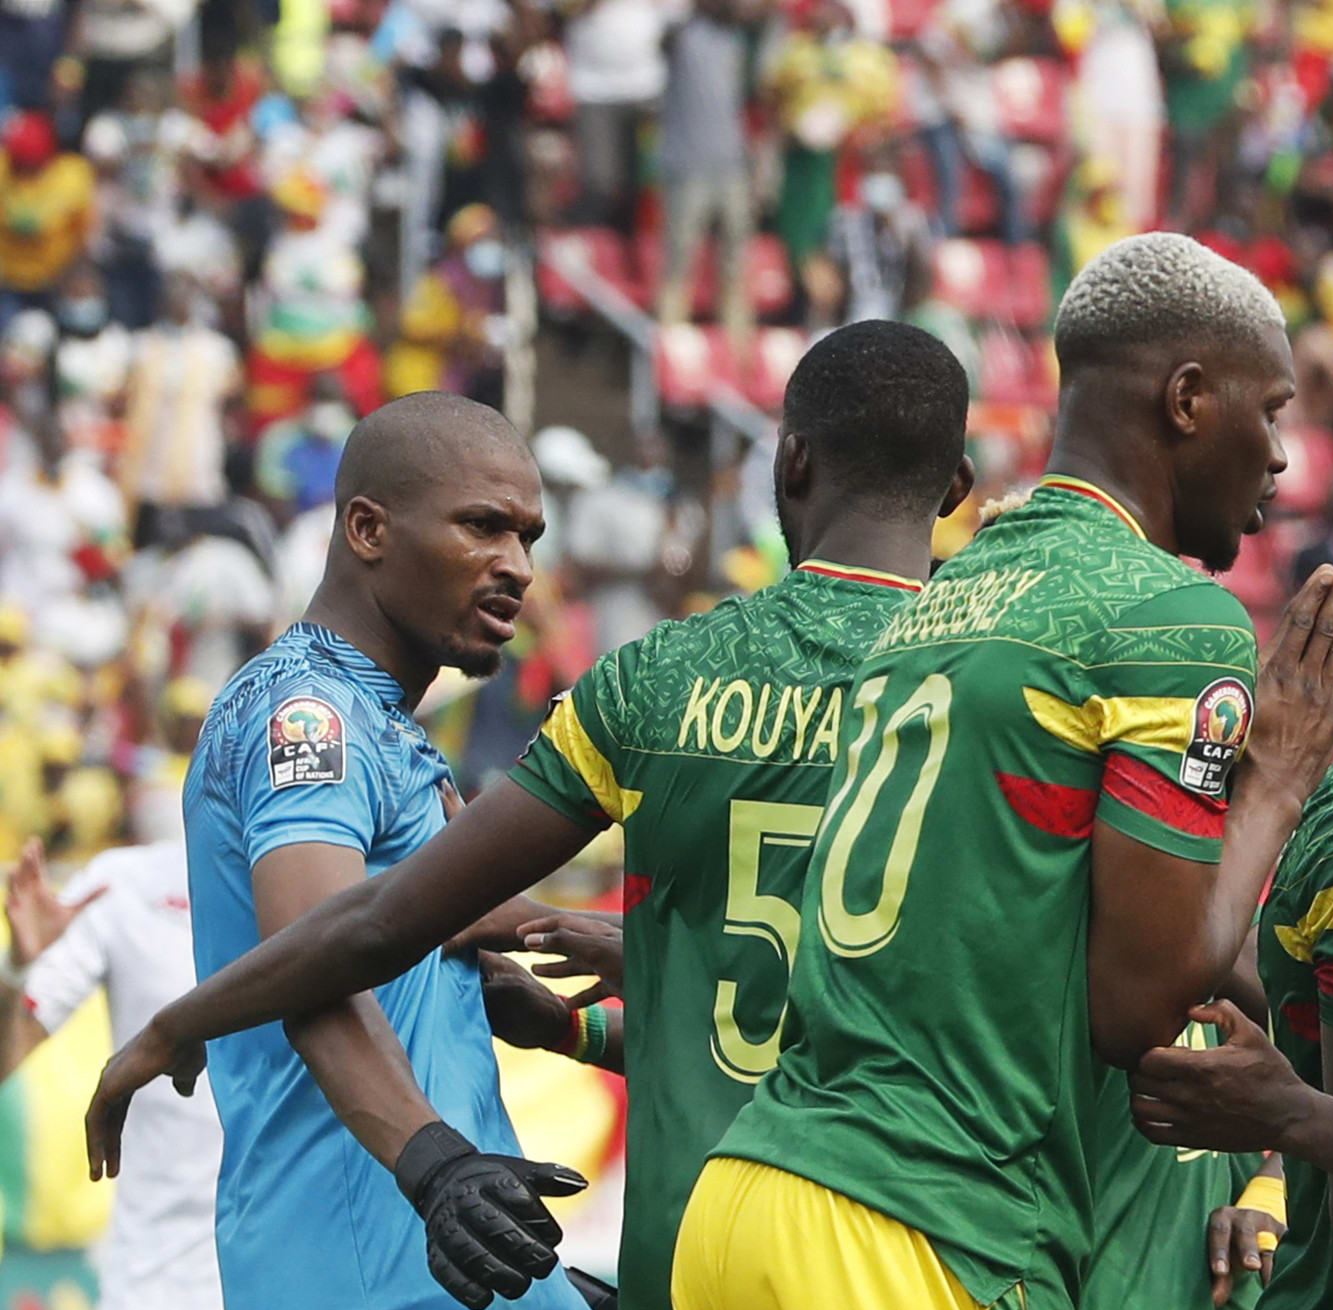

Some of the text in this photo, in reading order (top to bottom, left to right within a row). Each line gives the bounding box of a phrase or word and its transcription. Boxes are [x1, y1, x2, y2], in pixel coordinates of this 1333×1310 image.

[283, 743, 328, 757] CAF
[1203, 744, 1233, 759] CAF
[710, 798, 825, 1085] 5
